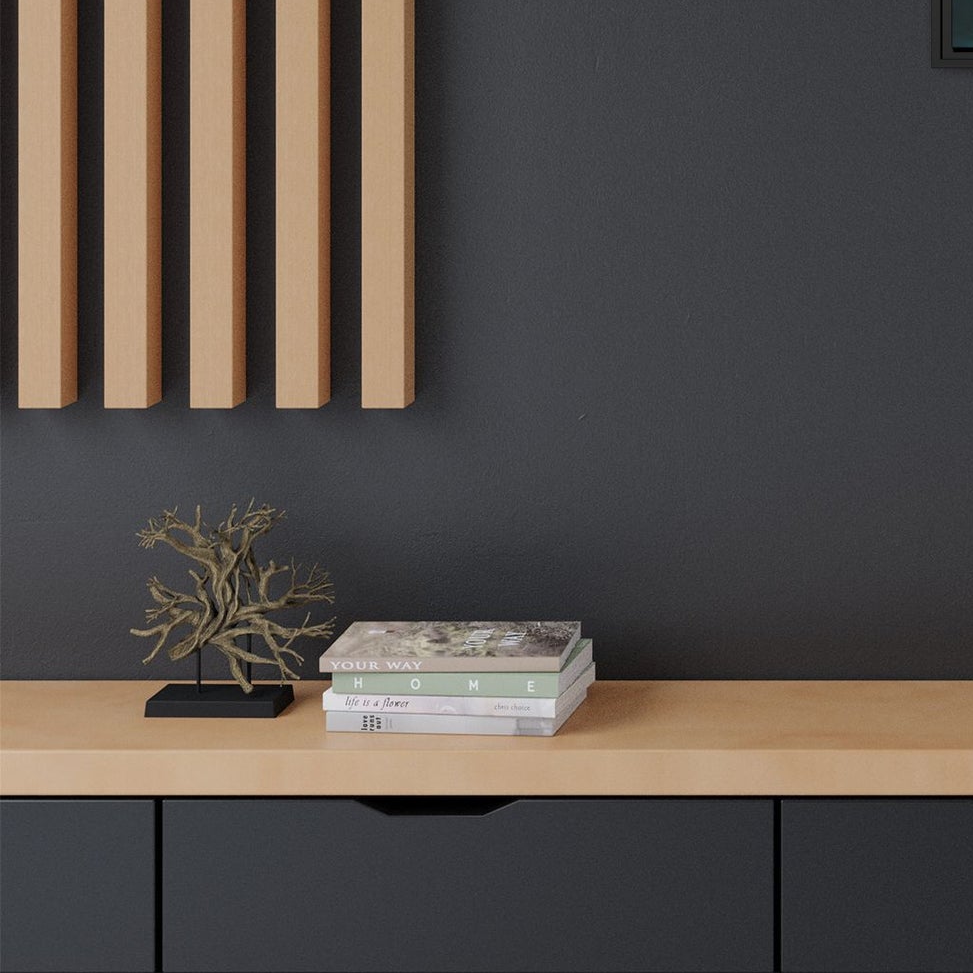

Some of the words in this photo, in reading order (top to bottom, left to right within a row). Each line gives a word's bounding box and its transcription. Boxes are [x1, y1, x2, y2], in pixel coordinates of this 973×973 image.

[463, 628, 495, 649] YOUR
[331, 661, 379, 670] YOUR
[387, 661, 422, 670] WAY
[345, 696, 360, 709] life
[362, 699, 370, 707] is
[380, 697, 409, 710] flower
